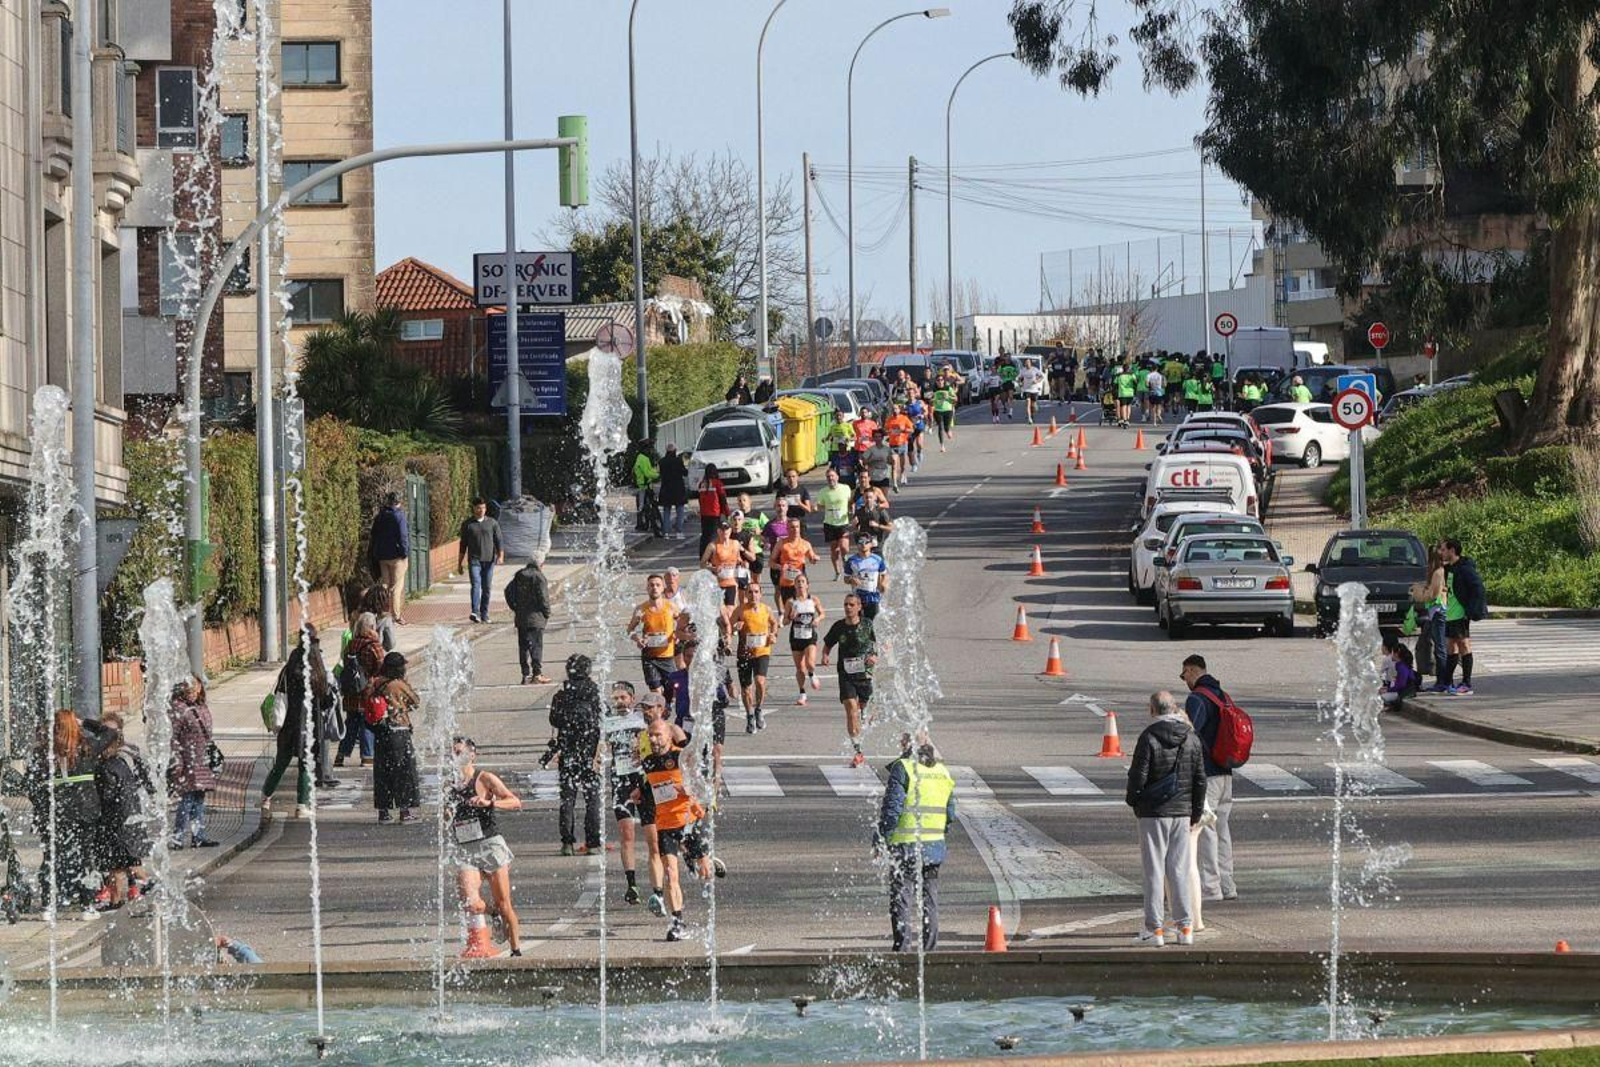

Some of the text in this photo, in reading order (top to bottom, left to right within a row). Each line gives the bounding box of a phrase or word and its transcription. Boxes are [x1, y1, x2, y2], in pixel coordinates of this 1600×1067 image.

[482, 263, 567, 281] SORONIC
[483, 284, 567, 301] DF-ERVER
[1220, 320, 1232, 328] 50
[1342, 402, 1364, 415] 50
[1171, 469, 1200, 486] ctt
